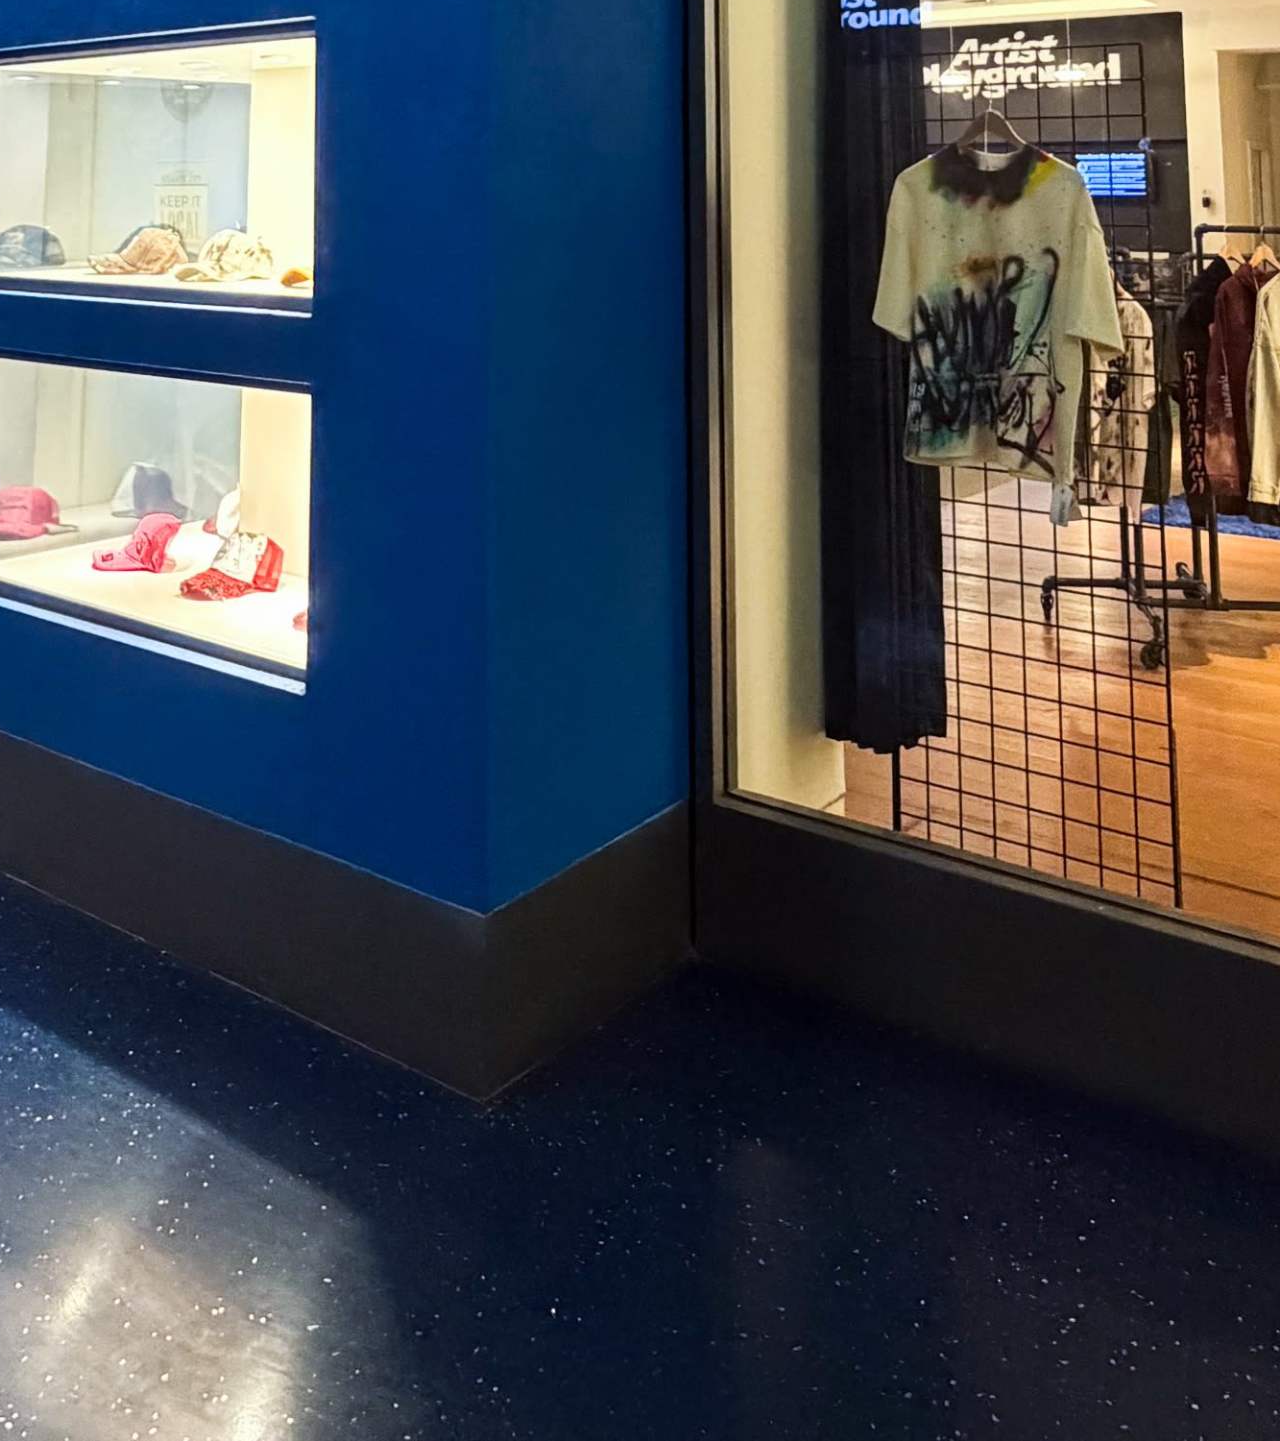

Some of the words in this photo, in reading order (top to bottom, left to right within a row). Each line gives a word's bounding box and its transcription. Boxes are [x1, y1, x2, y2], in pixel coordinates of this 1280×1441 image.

[840, 1, 933, 30] round
[952, 30, 1059, 67] Artist
[160, 195, 189, 209] KEEP
